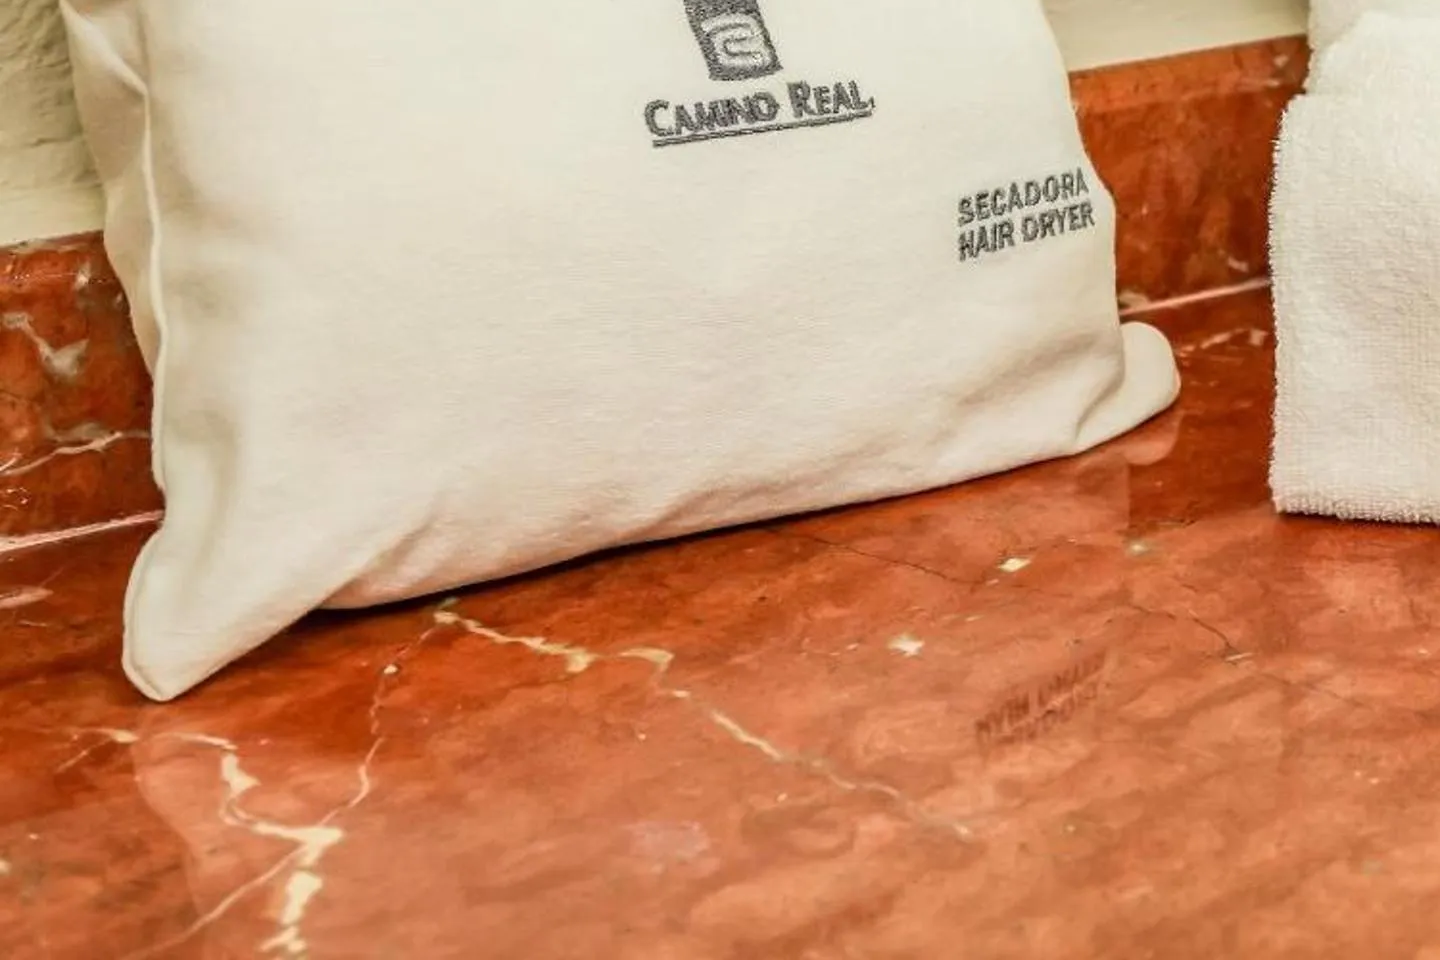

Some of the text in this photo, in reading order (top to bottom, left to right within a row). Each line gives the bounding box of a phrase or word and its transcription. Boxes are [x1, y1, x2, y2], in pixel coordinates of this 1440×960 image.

[644, 91, 780, 137] CAMINO
[957, 167, 1090, 227] SECADORA
[957, 199, 1096, 262] HAIR DRYER
